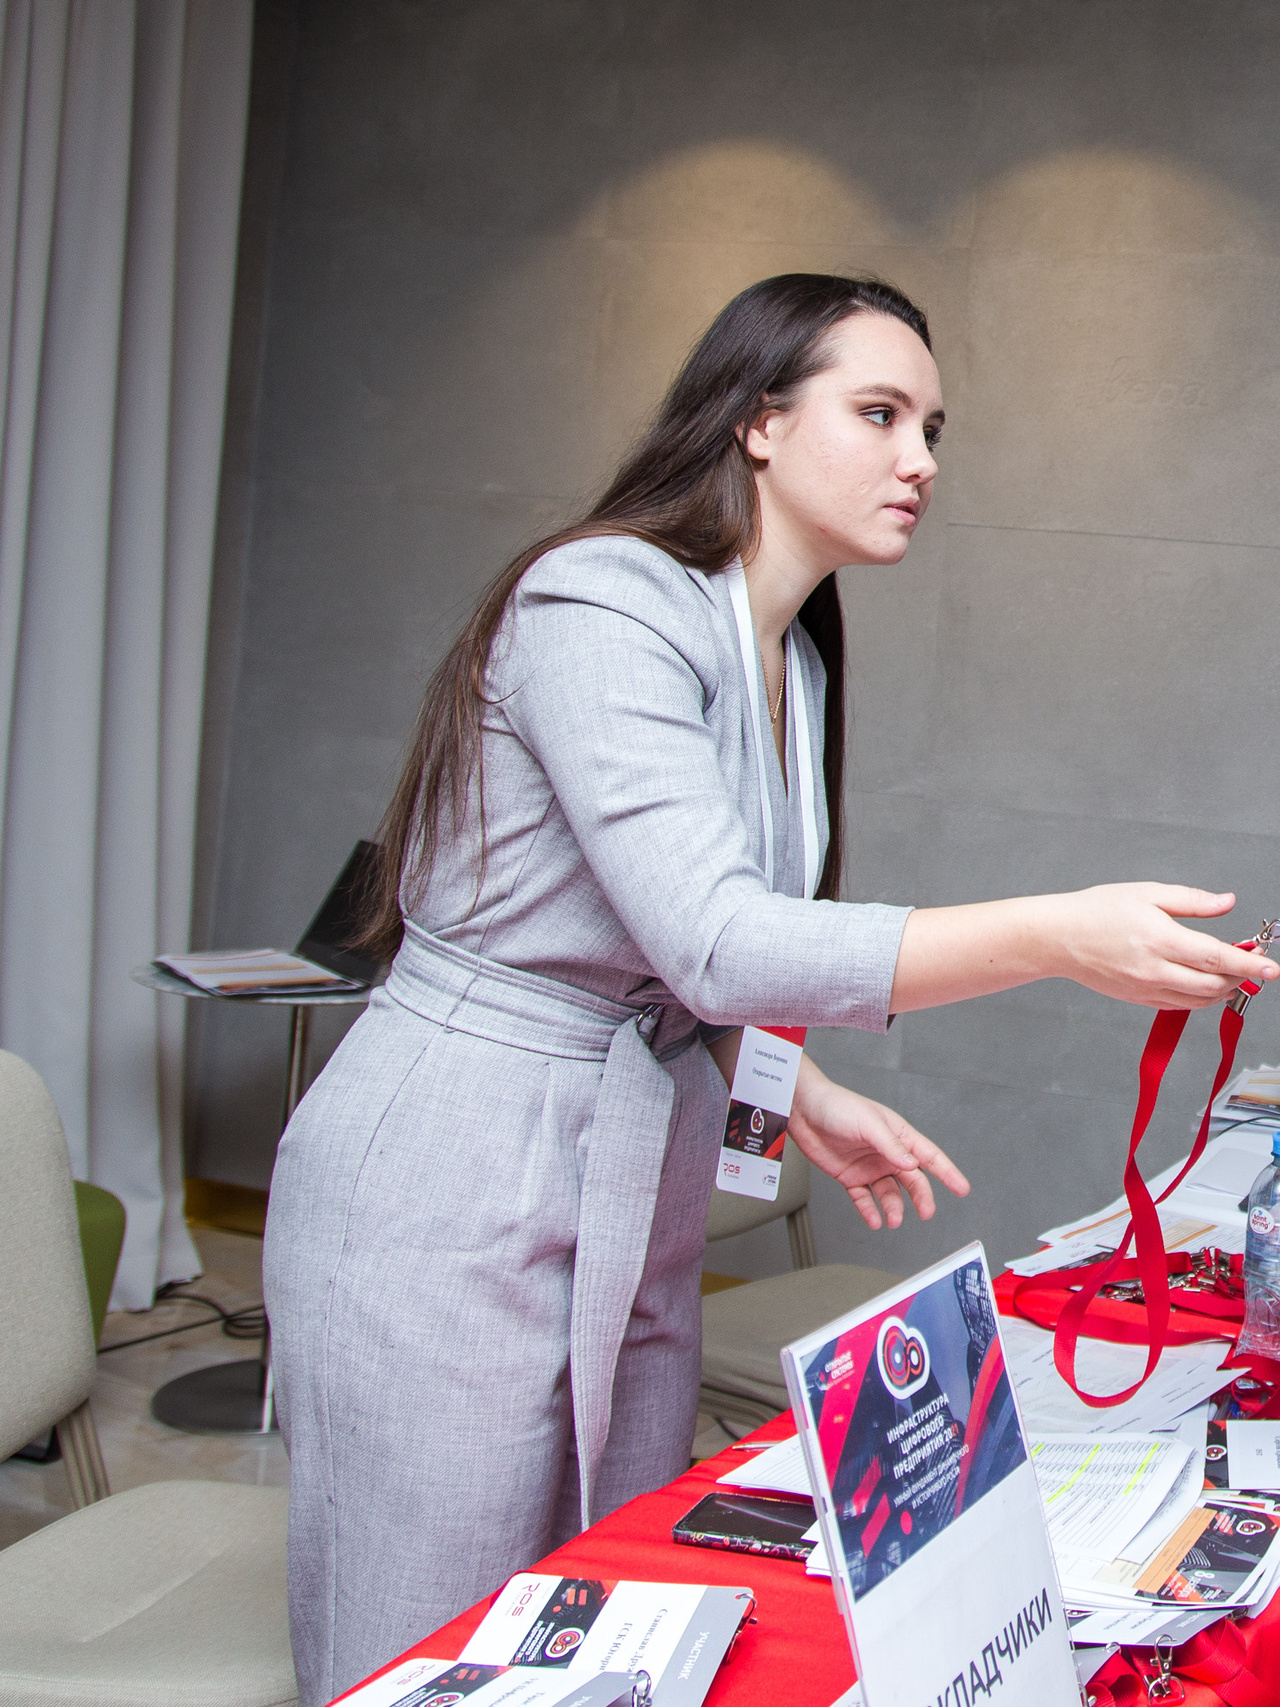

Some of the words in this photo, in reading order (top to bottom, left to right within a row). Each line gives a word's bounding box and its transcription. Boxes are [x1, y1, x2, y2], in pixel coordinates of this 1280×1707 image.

[886, 1392, 950, 1445] ИНФРАСТРУКТУРА
[900, 1415, 945, 1456] ЦИФРОВОГО
[892, 1433, 945, 1480] ПРЕДПРИЯТИЯ
[943, 1425, 960, 1446] 2021
[677, 1631, 711, 1680] УЧАСТНИК
[928, 1587, 1053, 1707] ЛАДЧИКИ
